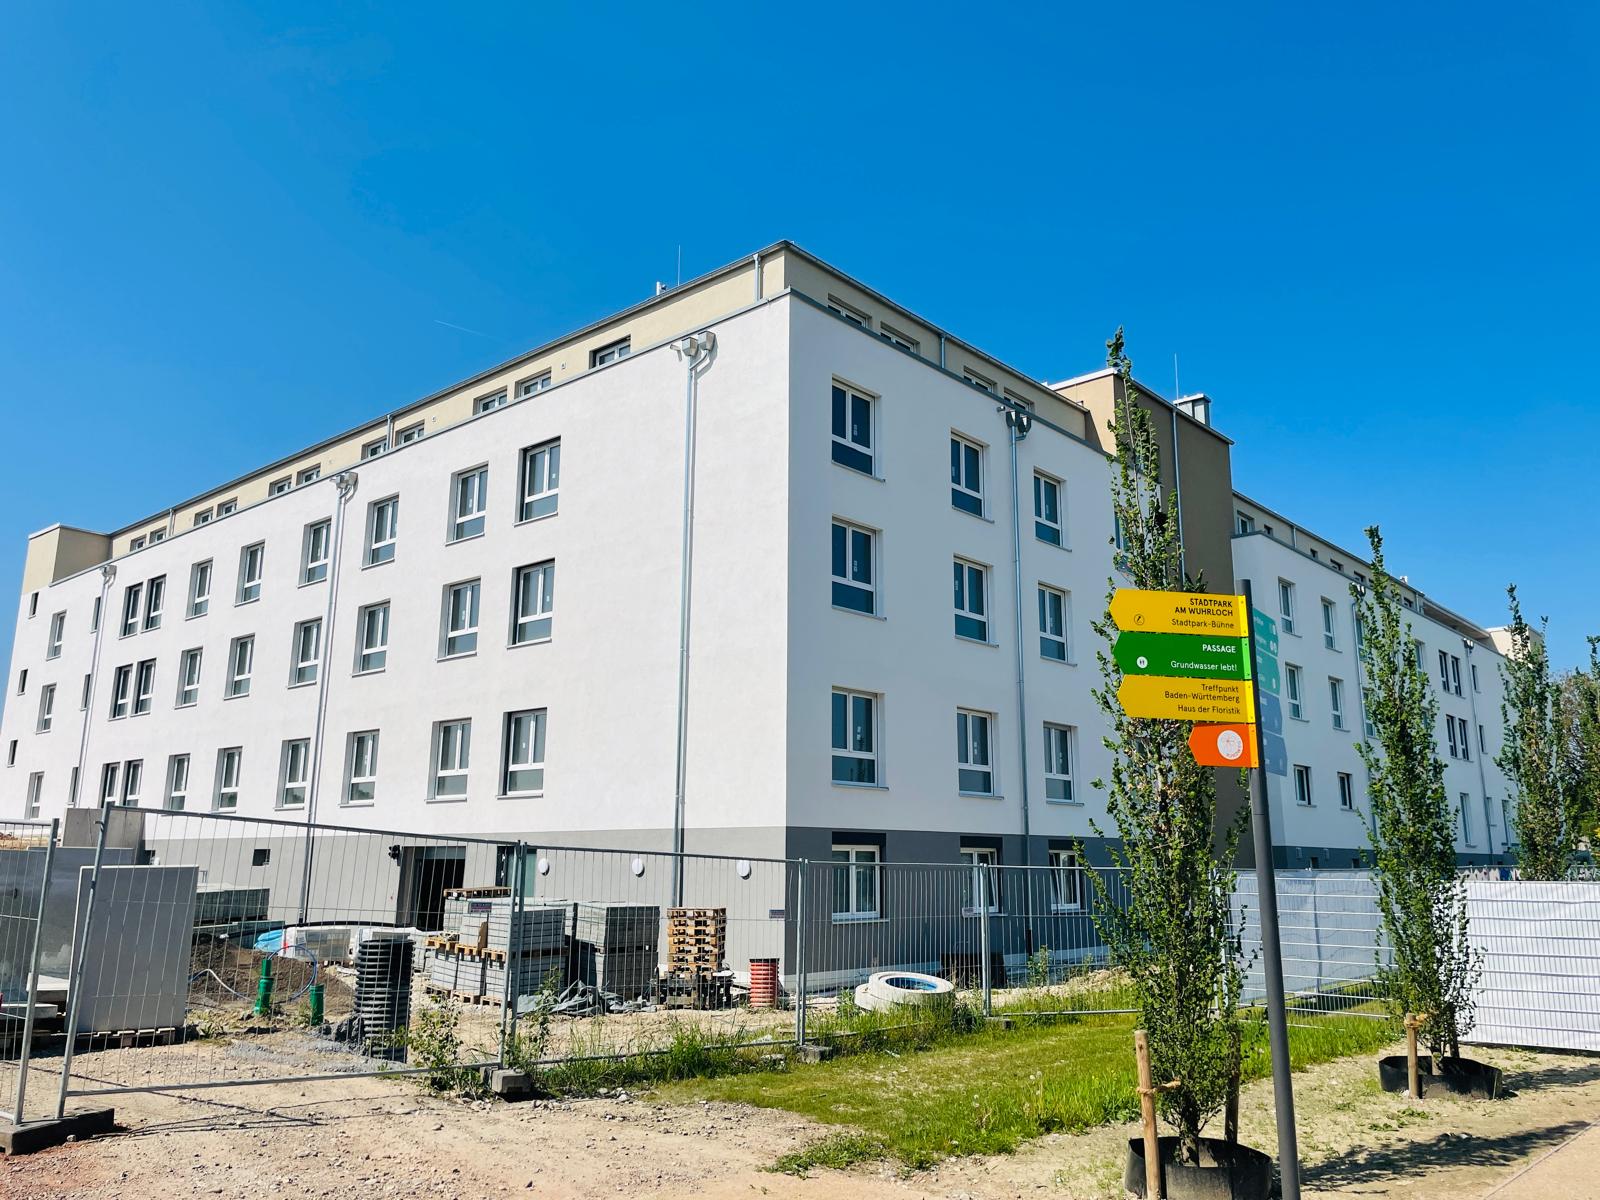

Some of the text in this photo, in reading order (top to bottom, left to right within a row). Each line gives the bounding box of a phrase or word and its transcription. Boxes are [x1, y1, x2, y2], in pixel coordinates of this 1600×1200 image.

[1190, 598, 1233, 608] STADTPARK
[1175, 606, 1234, 617] AM WUHRLOCH
[1172, 618, 1234, 629] Stadtpark-Bühne
[1202, 644, 1237, 653] PASSAGE
[1171, 661, 1238, 672] Grundwasser lebt!
[1202, 684, 1239, 693] Treffpunkt
[1165, 691, 1240, 703] Baden-Württemberg
[1178, 705, 1196, 713] Haus
